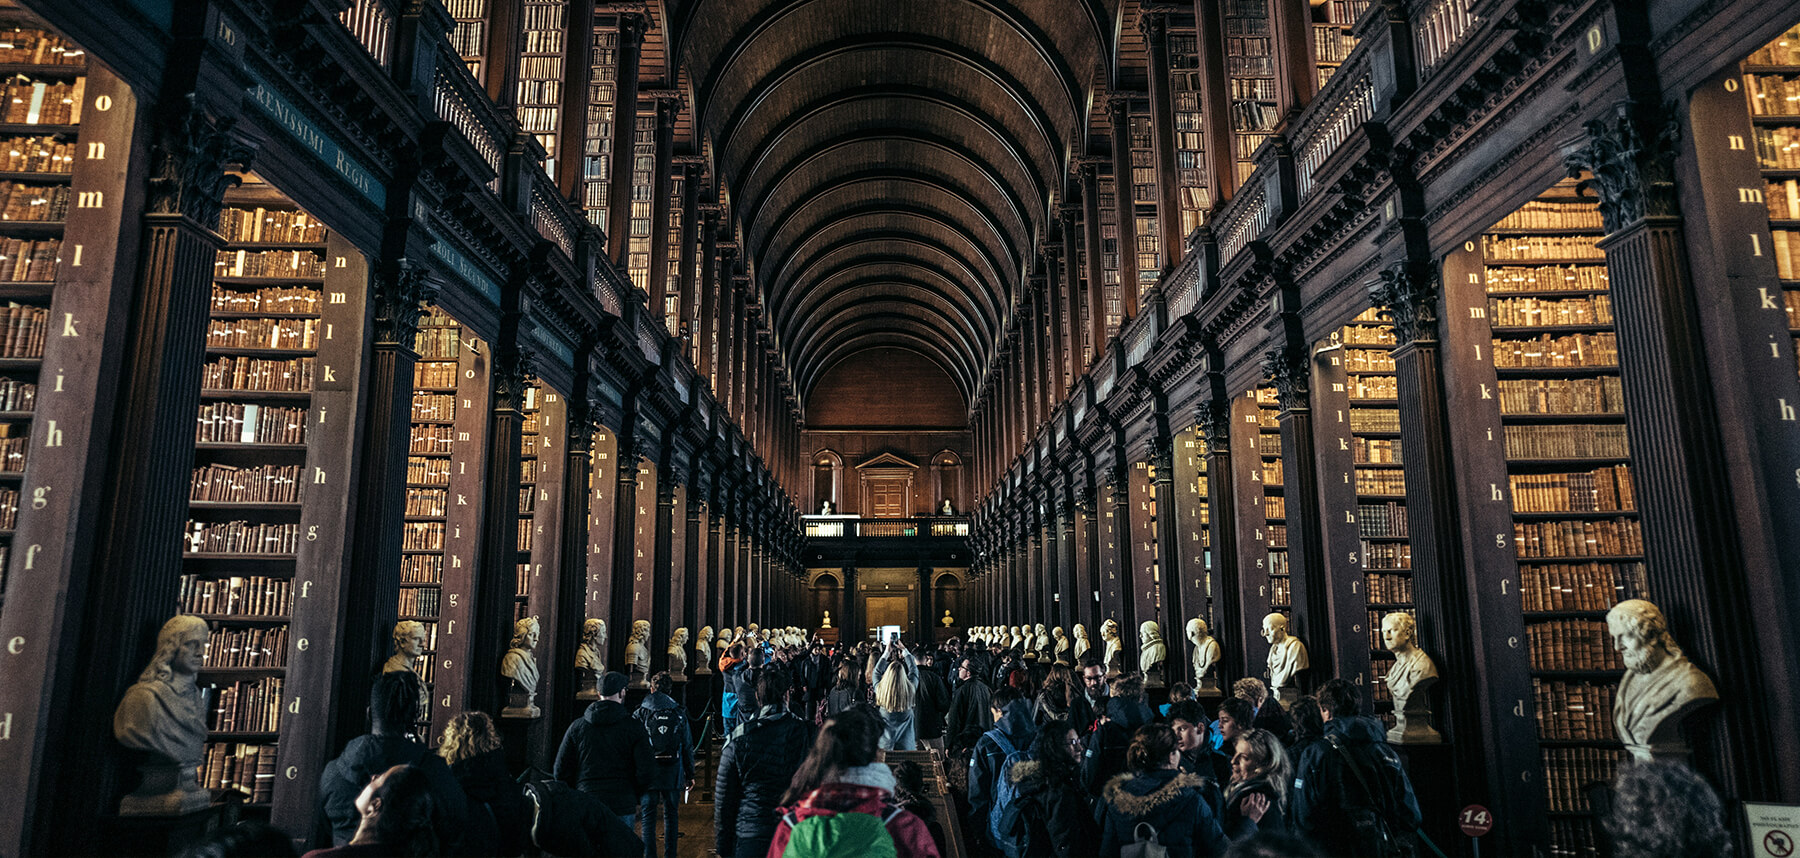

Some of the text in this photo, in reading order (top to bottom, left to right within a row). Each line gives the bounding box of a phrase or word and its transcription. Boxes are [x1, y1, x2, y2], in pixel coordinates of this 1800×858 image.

[1587, 25, 1601, 54] D
[1724, 79, 1738, 92] o
[95, 95, 112, 111] o
[1728, 135, 1745, 150] n
[87, 142, 105, 160] n
[336, 150, 369, 194] REGIS
[78, 191, 103, 208] m
[1738, 188, 1763, 203] m
[1465, 241, 1475, 252] o
[335, 257, 346, 268] n
[1468, 273, 1479, 284] n
[330, 292, 346, 304] m
[1758, 288, 1778, 309] k
[1469, 307, 1485, 318] m
[61, 313, 79, 337] k
[1769, 335, 1779, 358] i
[1331, 356, 1340, 366] n
[54, 368, 64, 392] i
[324, 365, 336, 382] k
[465, 369, 475, 379] o
[1480, 384, 1491, 399] k
[319, 406, 326, 423] i
[1779, 399, 1796, 421] h
[45, 420, 62, 447] h
[1487, 427, 1492, 441] i
[543, 437, 551, 447] k
[1339, 438, 1348, 450] k
[542, 461, 546, 472] i
[314, 467, 326, 484] h
[1251, 470, 1260, 481] k
[1344, 472, 1348, 483] i
[540, 489, 548, 500] h
[596, 489, 602, 499] k
[1190, 483, 1197, 493] k
[1490, 484, 1503, 500] h
[32, 486, 51, 509] g
[457, 494, 467, 505] k
[1346, 511, 1355, 523] h
[306, 525, 319, 541] g
[454, 524, 460, 538] i
[1256, 529, 1263, 540] h
[1496, 534, 1506, 548] g
[25, 544, 41, 570] f
[452, 555, 461, 568] h
[1349, 552, 1357, 564] g
[301, 581, 312, 598] f
[1501, 579, 1509, 594] f
[450, 594, 459, 607] g
[447, 620, 456, 634] f
[8, 636, 25, 654] e
[297, 638, 308, 651] e
[1508, 637, 1517, 648] e
[1355, 673, 1363, 685] d
[289, 697, 300, 714] d
[442, 695, 451, 707] d
[1513, 700, 1524, 717] d
[286, 766, 297, 779] c
[1522, 771, 1531, 782] c
[1464, 810, 1486, 825] 14
